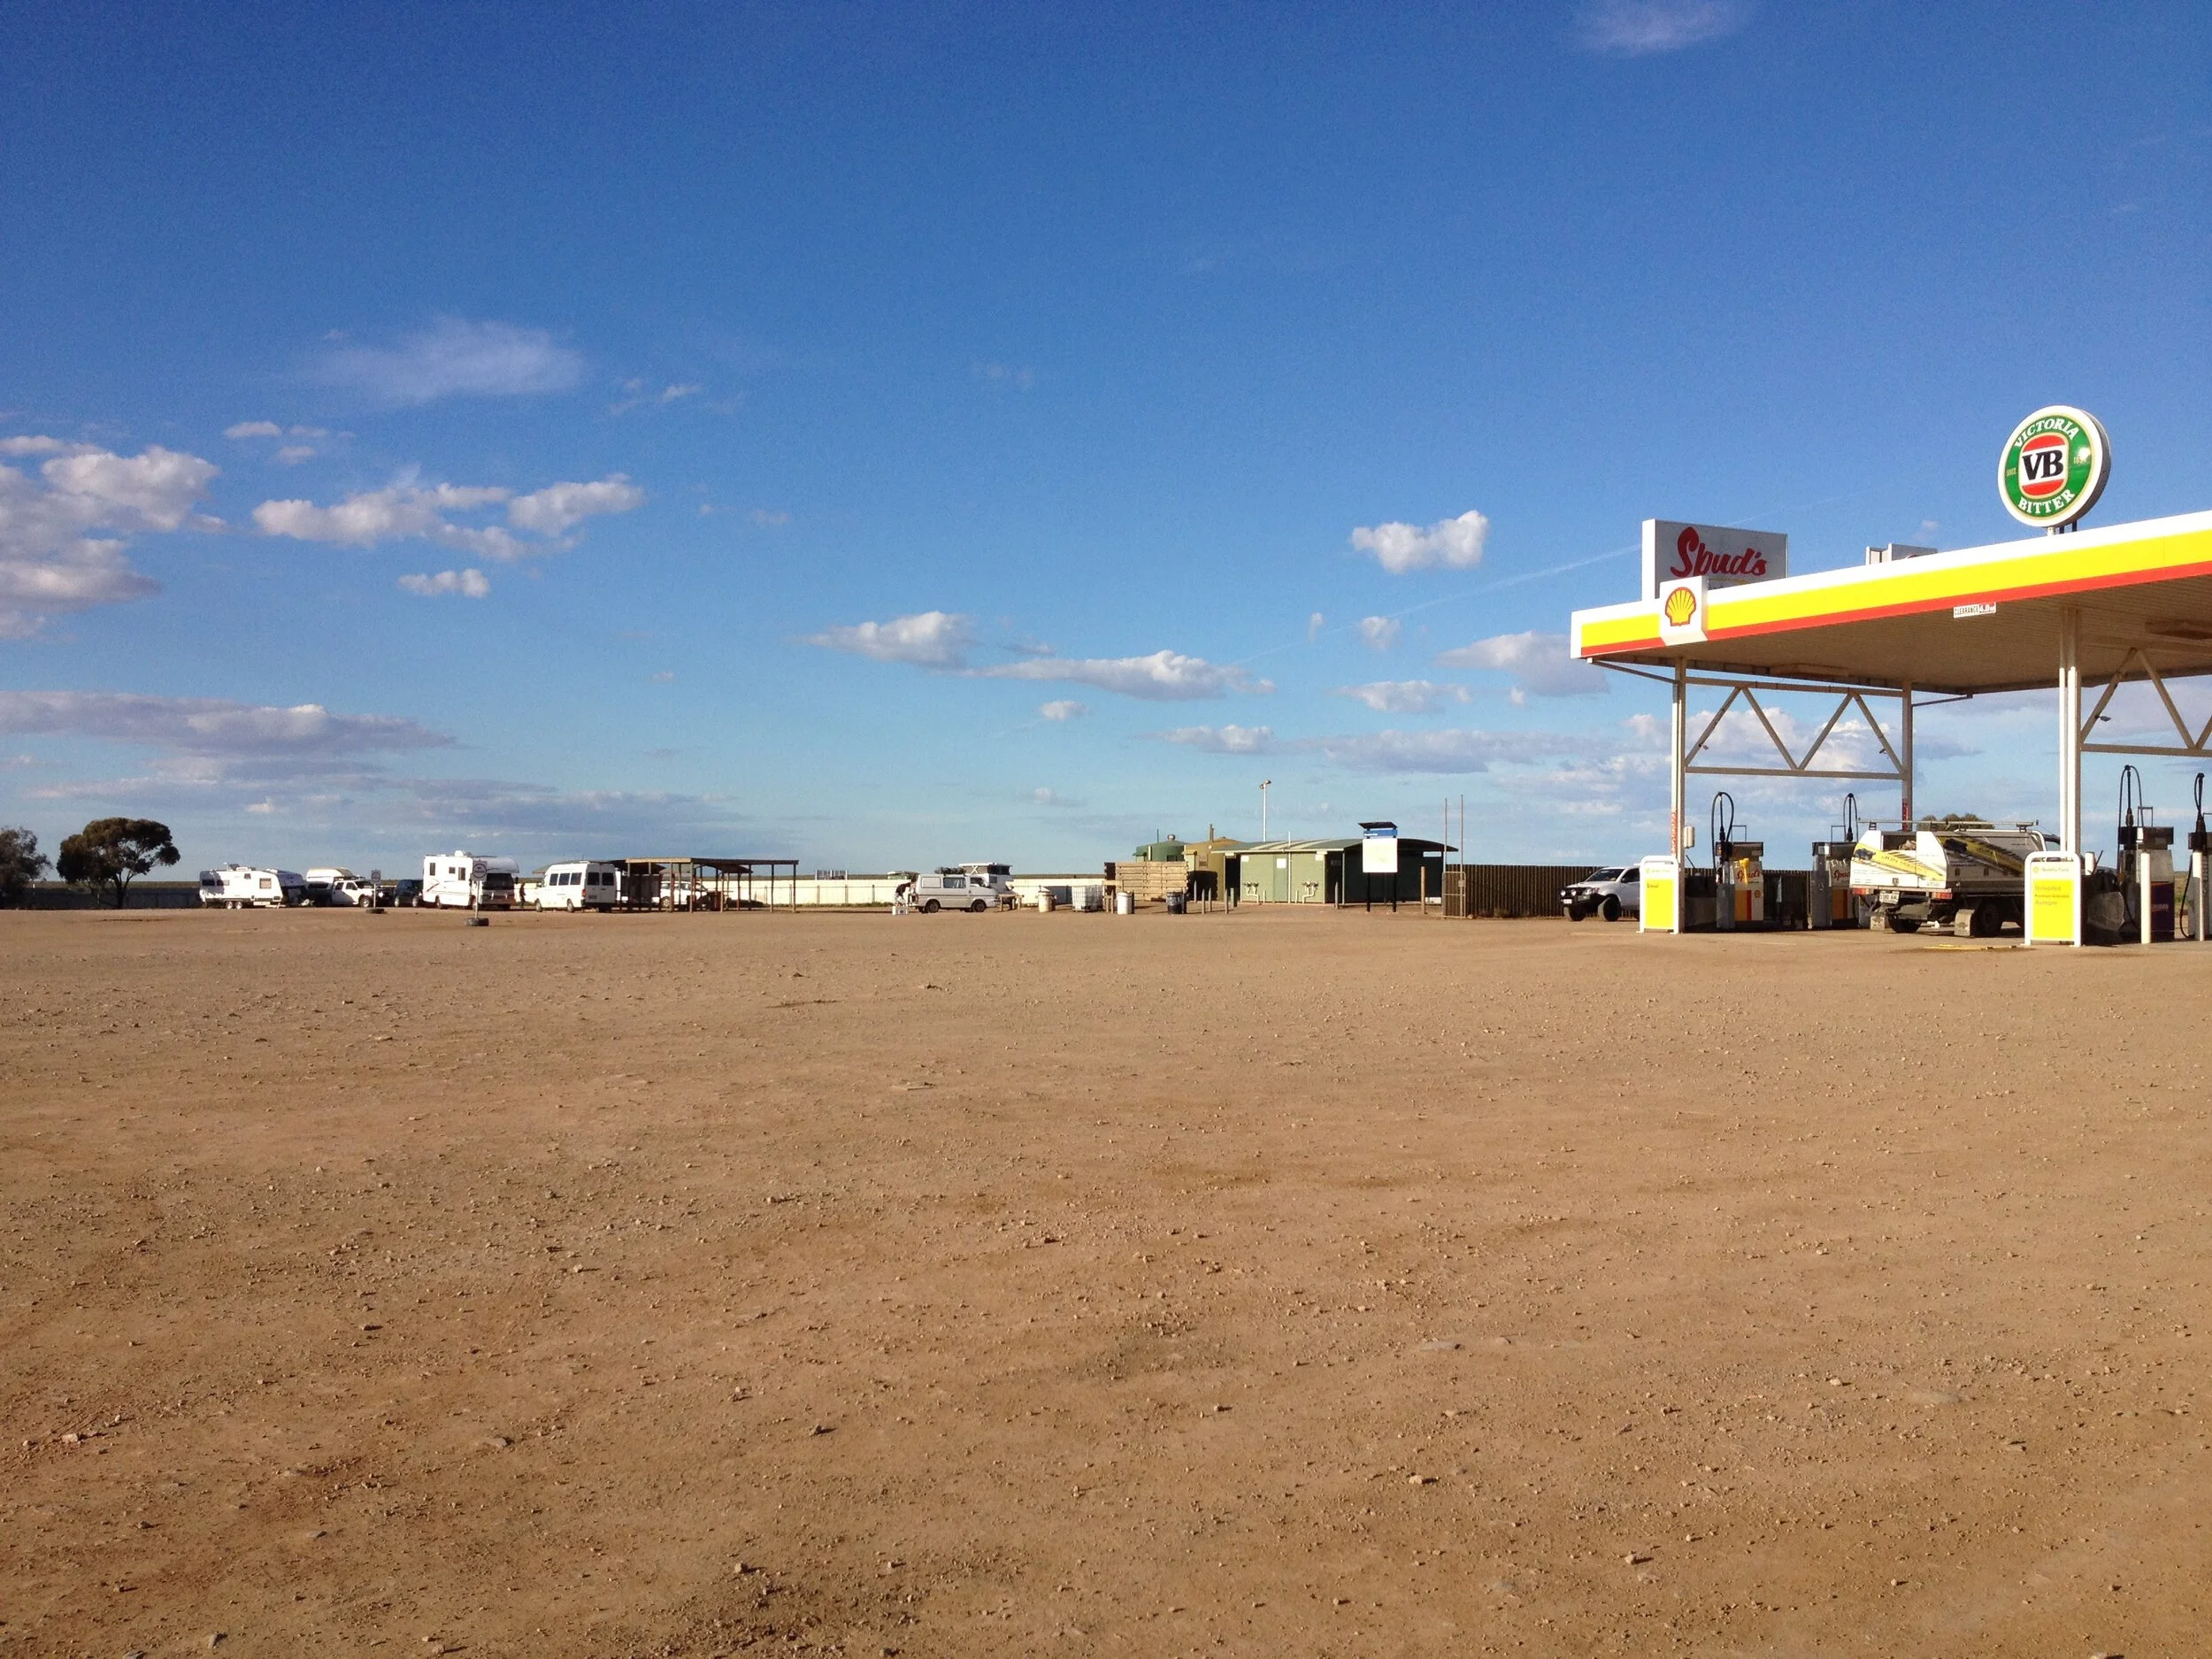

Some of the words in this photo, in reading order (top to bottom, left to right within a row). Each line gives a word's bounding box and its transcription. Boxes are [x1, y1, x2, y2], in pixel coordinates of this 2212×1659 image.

[2014, 418, 2079, 448] VICTORIA
[2022, 449, 2063, 480] VB
[2017, 489, 2076, 514] BITTER
